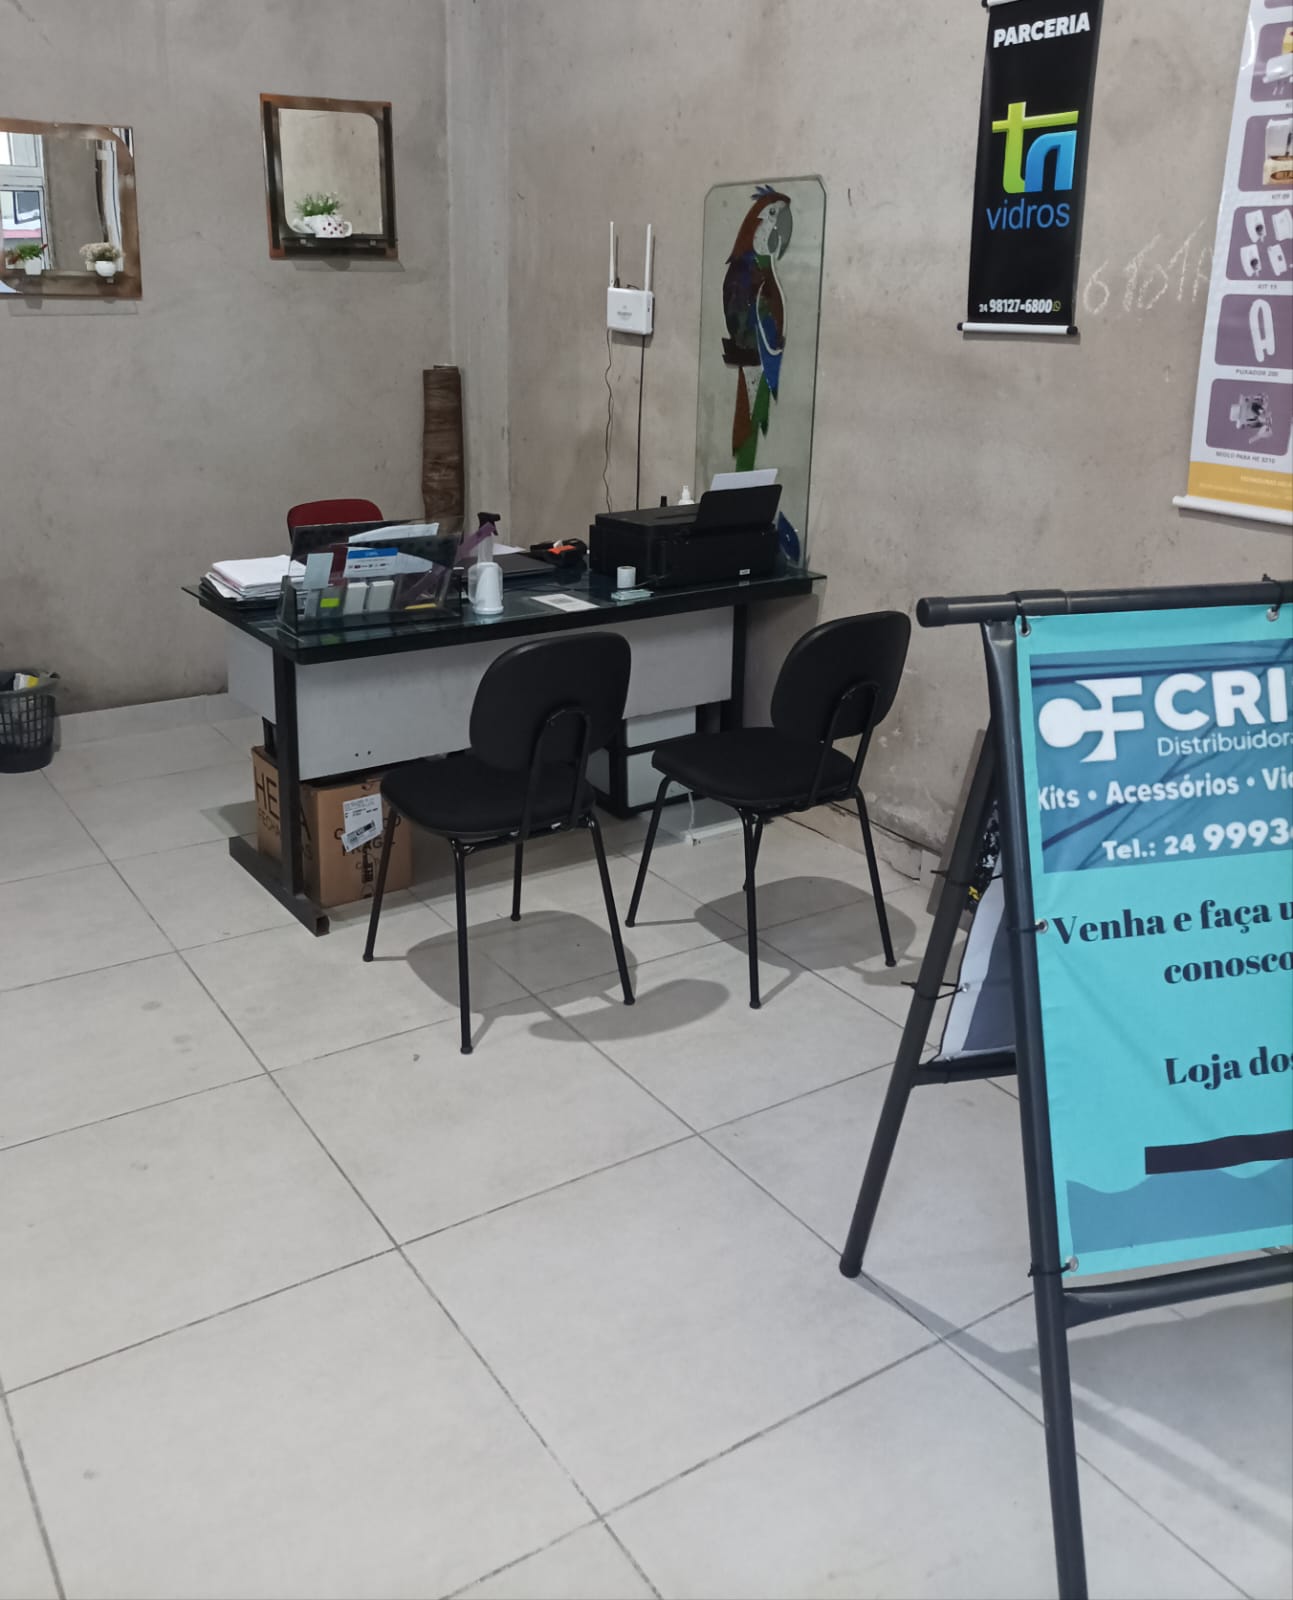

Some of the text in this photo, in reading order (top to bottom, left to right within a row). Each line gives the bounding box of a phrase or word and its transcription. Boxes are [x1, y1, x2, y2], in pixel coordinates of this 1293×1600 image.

[993, 12, 1090, 48] PARCERIA
[986, 198, 1071, 231] vidros
[989, 298, 1053, 314] 98127-6800
[1154, 667, 1293, 731] CRI
[1157, 729, 1293, 757] Distribuidor
[1038, 784, 1081, 811] Kits
[1106, 771, 1240, 806] Acessórios
[1102, 817, 1293, 861] Tel.: 24 9993
[1052, 908, 1167, 945] Venha
[1173, 911, 1193, 932] e
[1200, 899, 1272, 934] faça
[1163, 951, 1293, 985] conosco
[1164, 1046, 1293, 1090] Loja do
